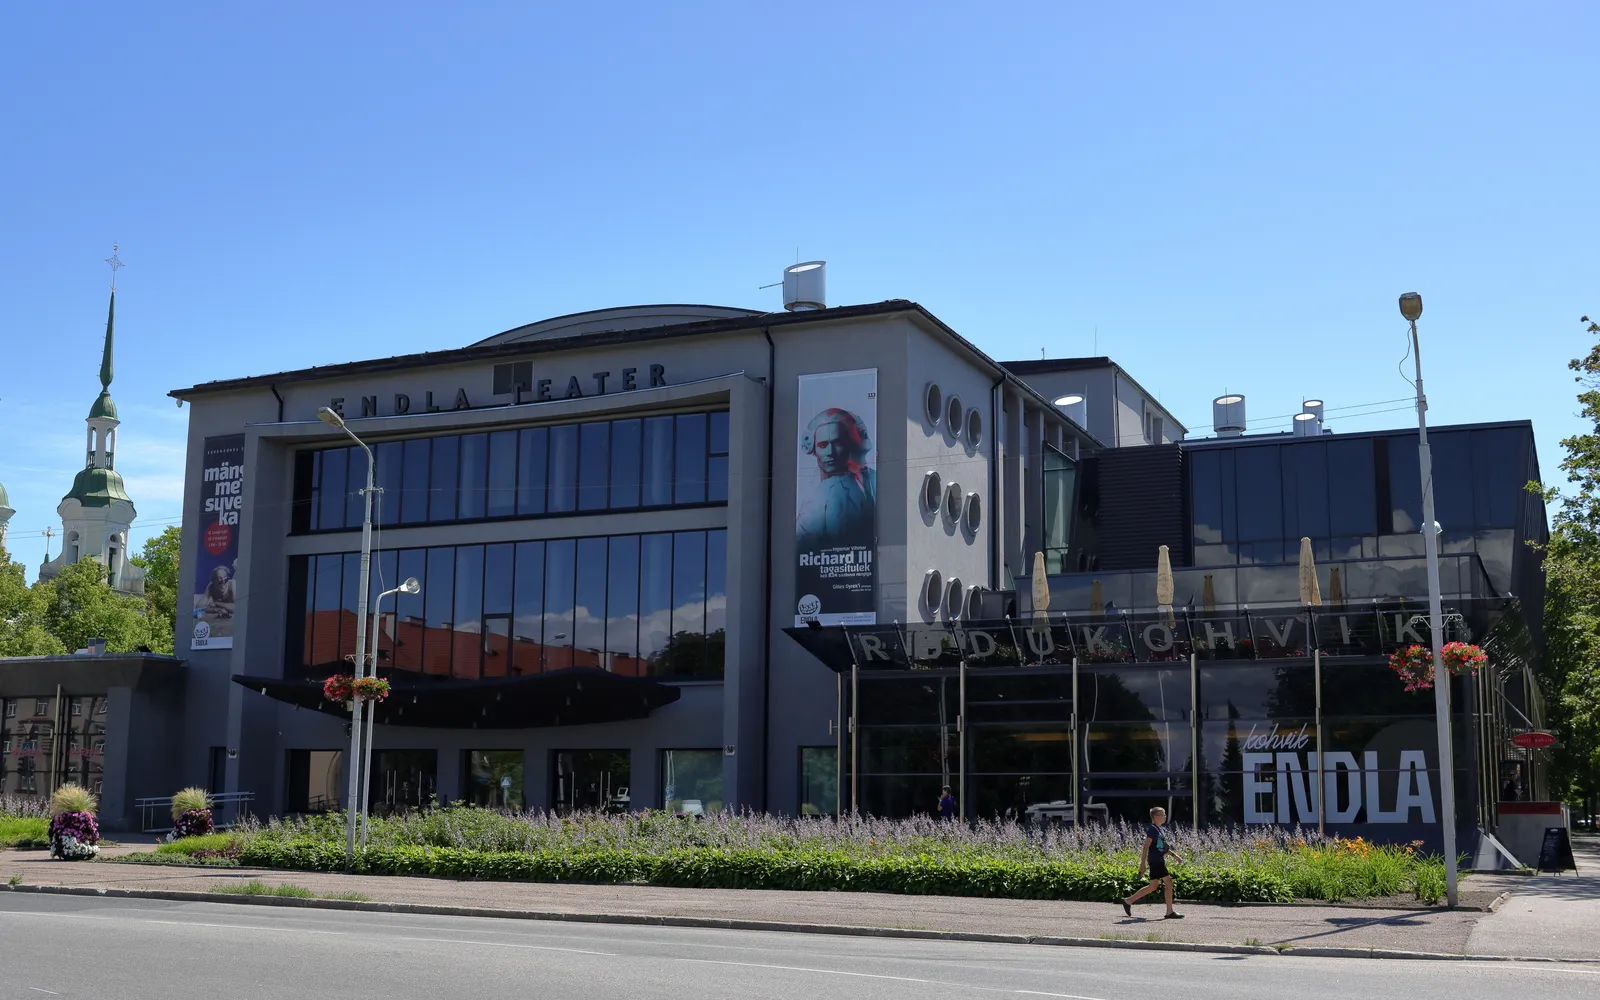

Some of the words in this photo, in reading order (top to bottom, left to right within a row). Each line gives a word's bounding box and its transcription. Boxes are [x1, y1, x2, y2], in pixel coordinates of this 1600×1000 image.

[331, 388, 472, 418] ENDLA
[510, 364, 666, 405] TEATER
[799, 550, 855, 567] Richard
[858, 550, 872, 563] III
[820, 561, 871, 575] tagasitulek
[1243, 723, 1309, 749] kohvik
[1242, 750, 1437, 824] ENDLA
